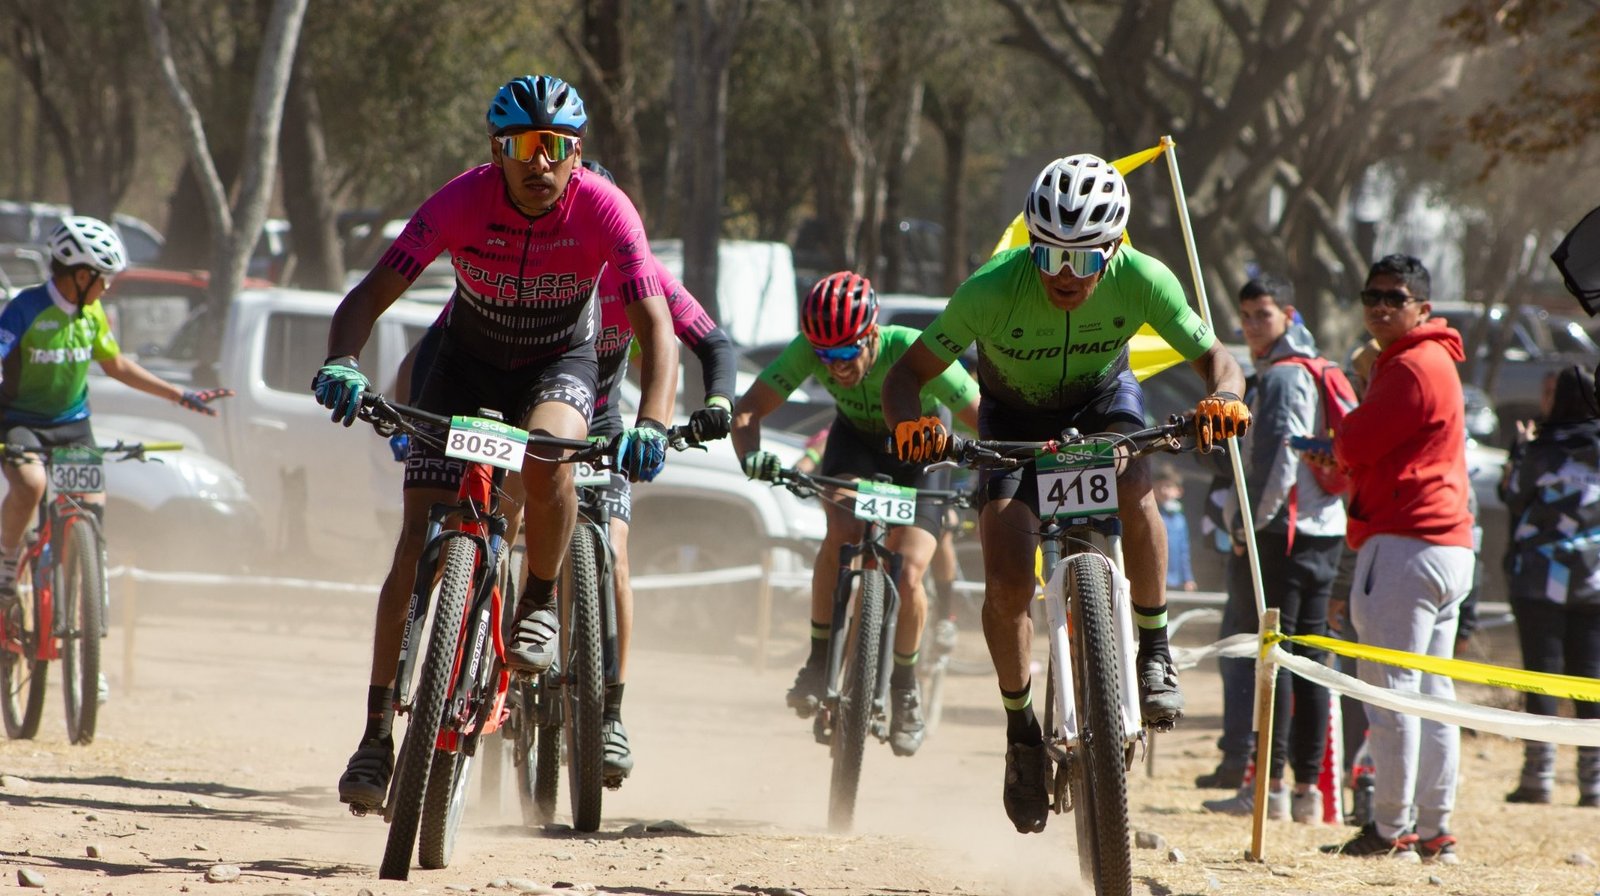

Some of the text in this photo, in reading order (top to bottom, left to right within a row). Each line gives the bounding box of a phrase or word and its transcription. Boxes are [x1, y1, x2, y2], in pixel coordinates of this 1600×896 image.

[498, 277, 593, 300] LERMA
[451, 433, 513, 461] 8052
[55, 466, 101, 489] 3050
[1047, 474, 1109, 507] 418
[861, 498, 913, 519] 418
